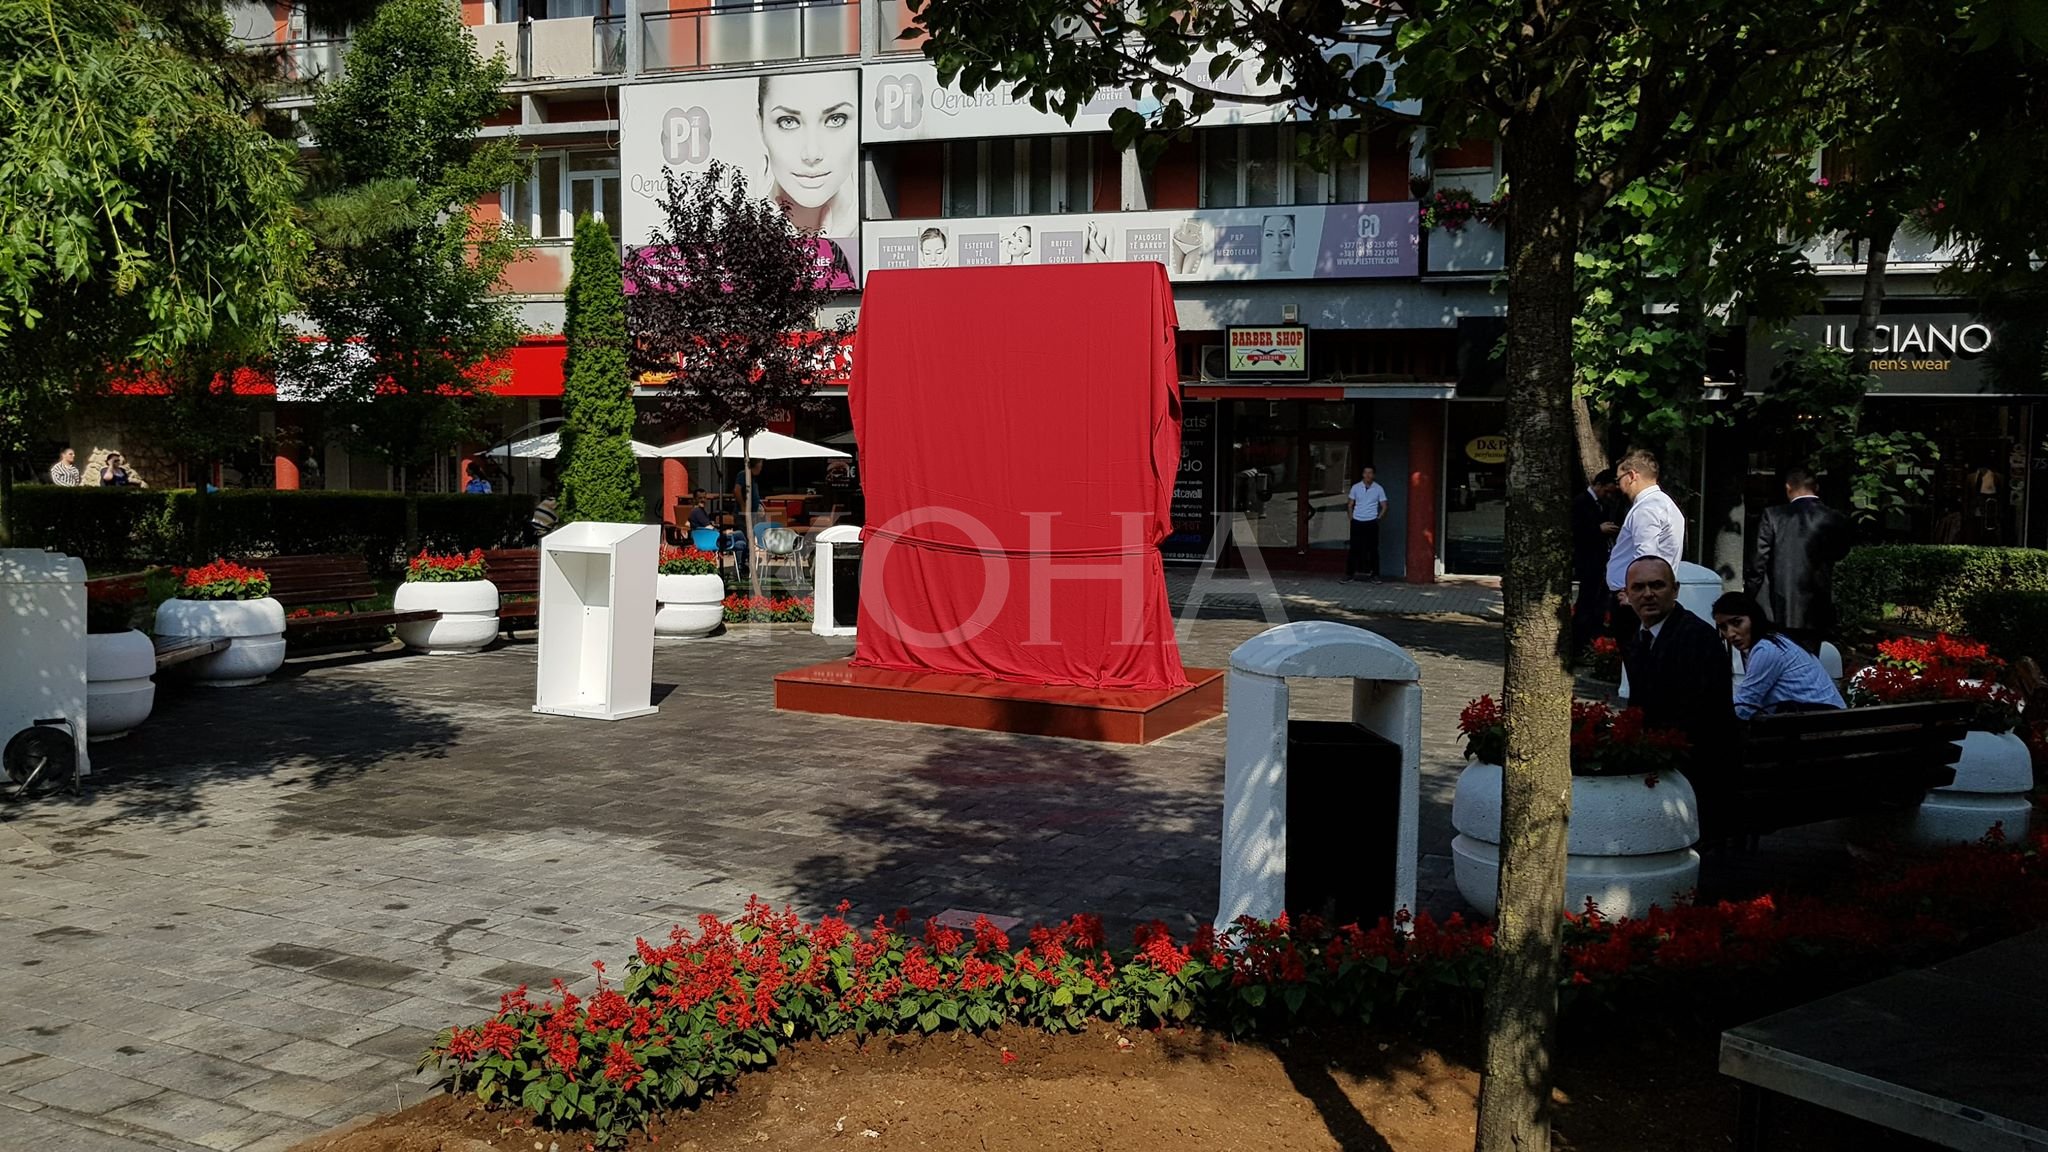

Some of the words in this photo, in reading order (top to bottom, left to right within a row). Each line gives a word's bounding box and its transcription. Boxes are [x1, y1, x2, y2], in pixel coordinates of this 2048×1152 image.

[1232, 331, 1273, 347] BARBER
[1276, 331, 1303, 346] SHOP
[1911, 359, 1951, 371] wear
